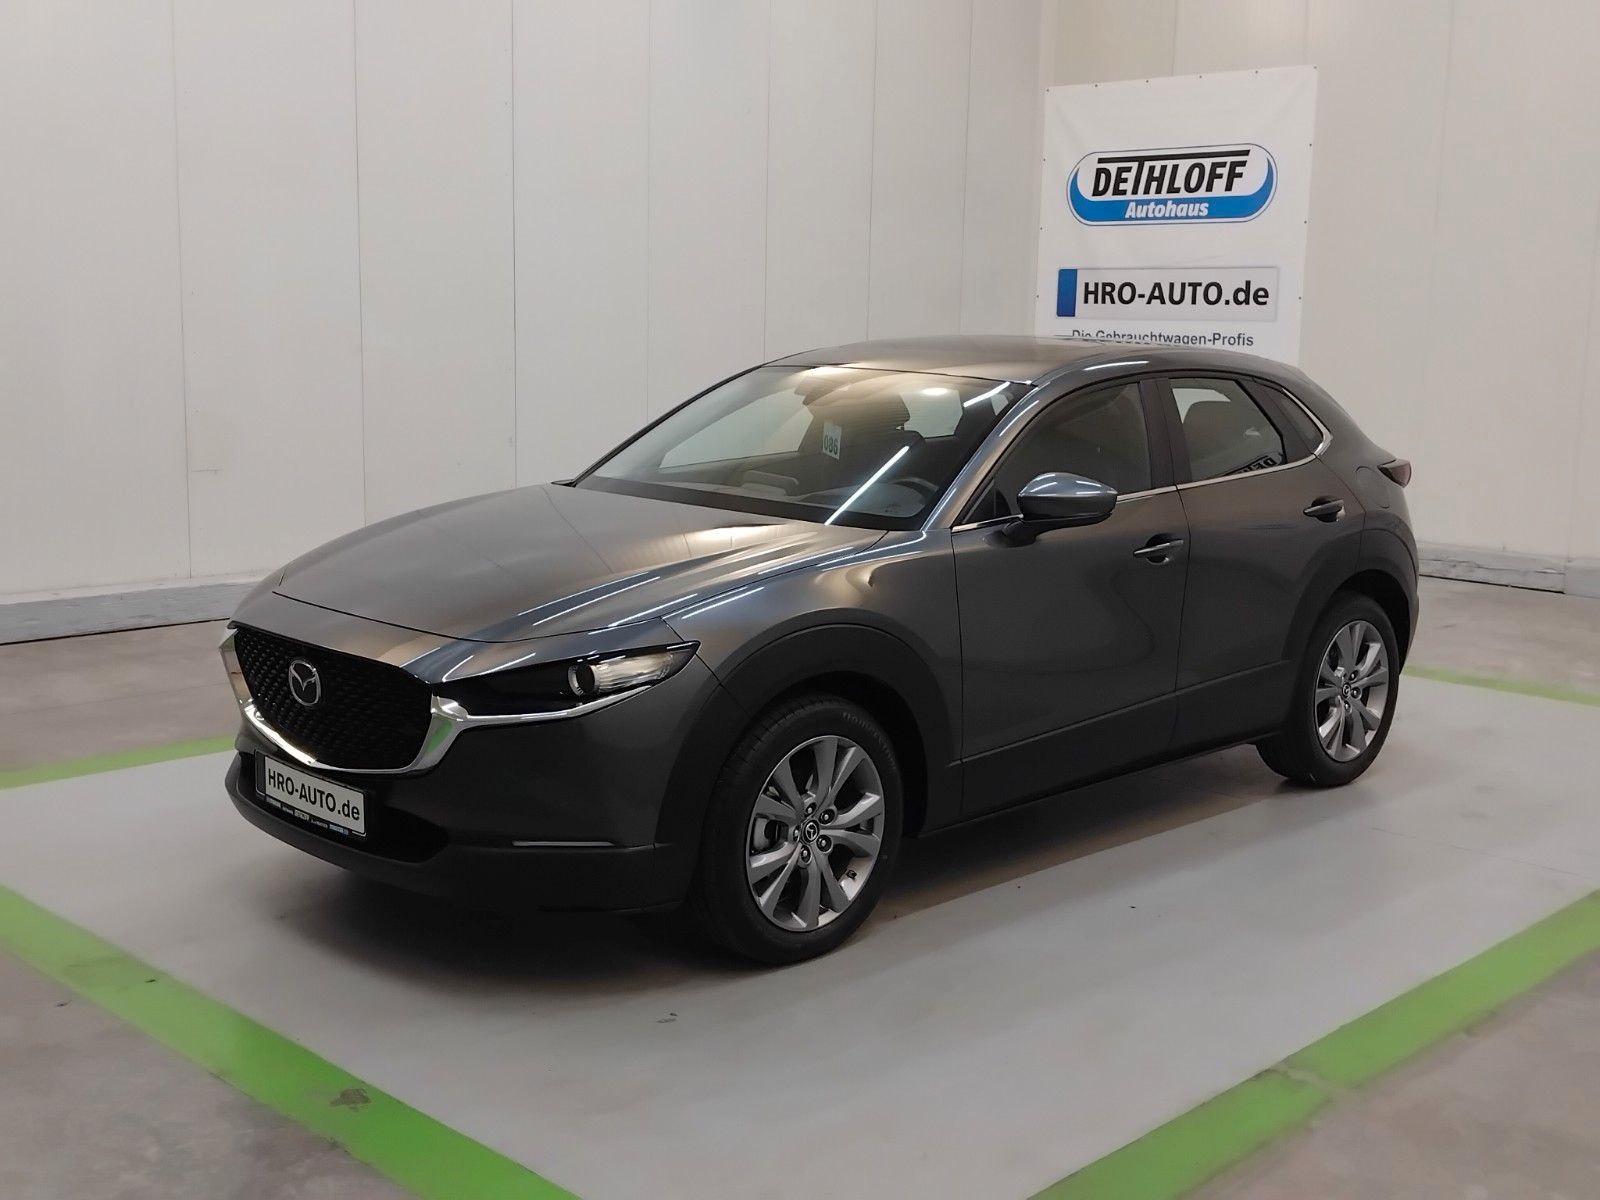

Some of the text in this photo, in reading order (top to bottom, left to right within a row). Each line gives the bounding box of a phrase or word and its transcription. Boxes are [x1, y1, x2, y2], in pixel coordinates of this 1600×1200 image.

[1091, 150, 1250, 197] DETHLOFF
[1124, 201, 1209, 219] Autohaus
[1083, 280, 1270, 306] HRO-AUTO.de
[824, 434, 839, 455] 086
[268, 768, 360, 821] HRO-AUTO.de
